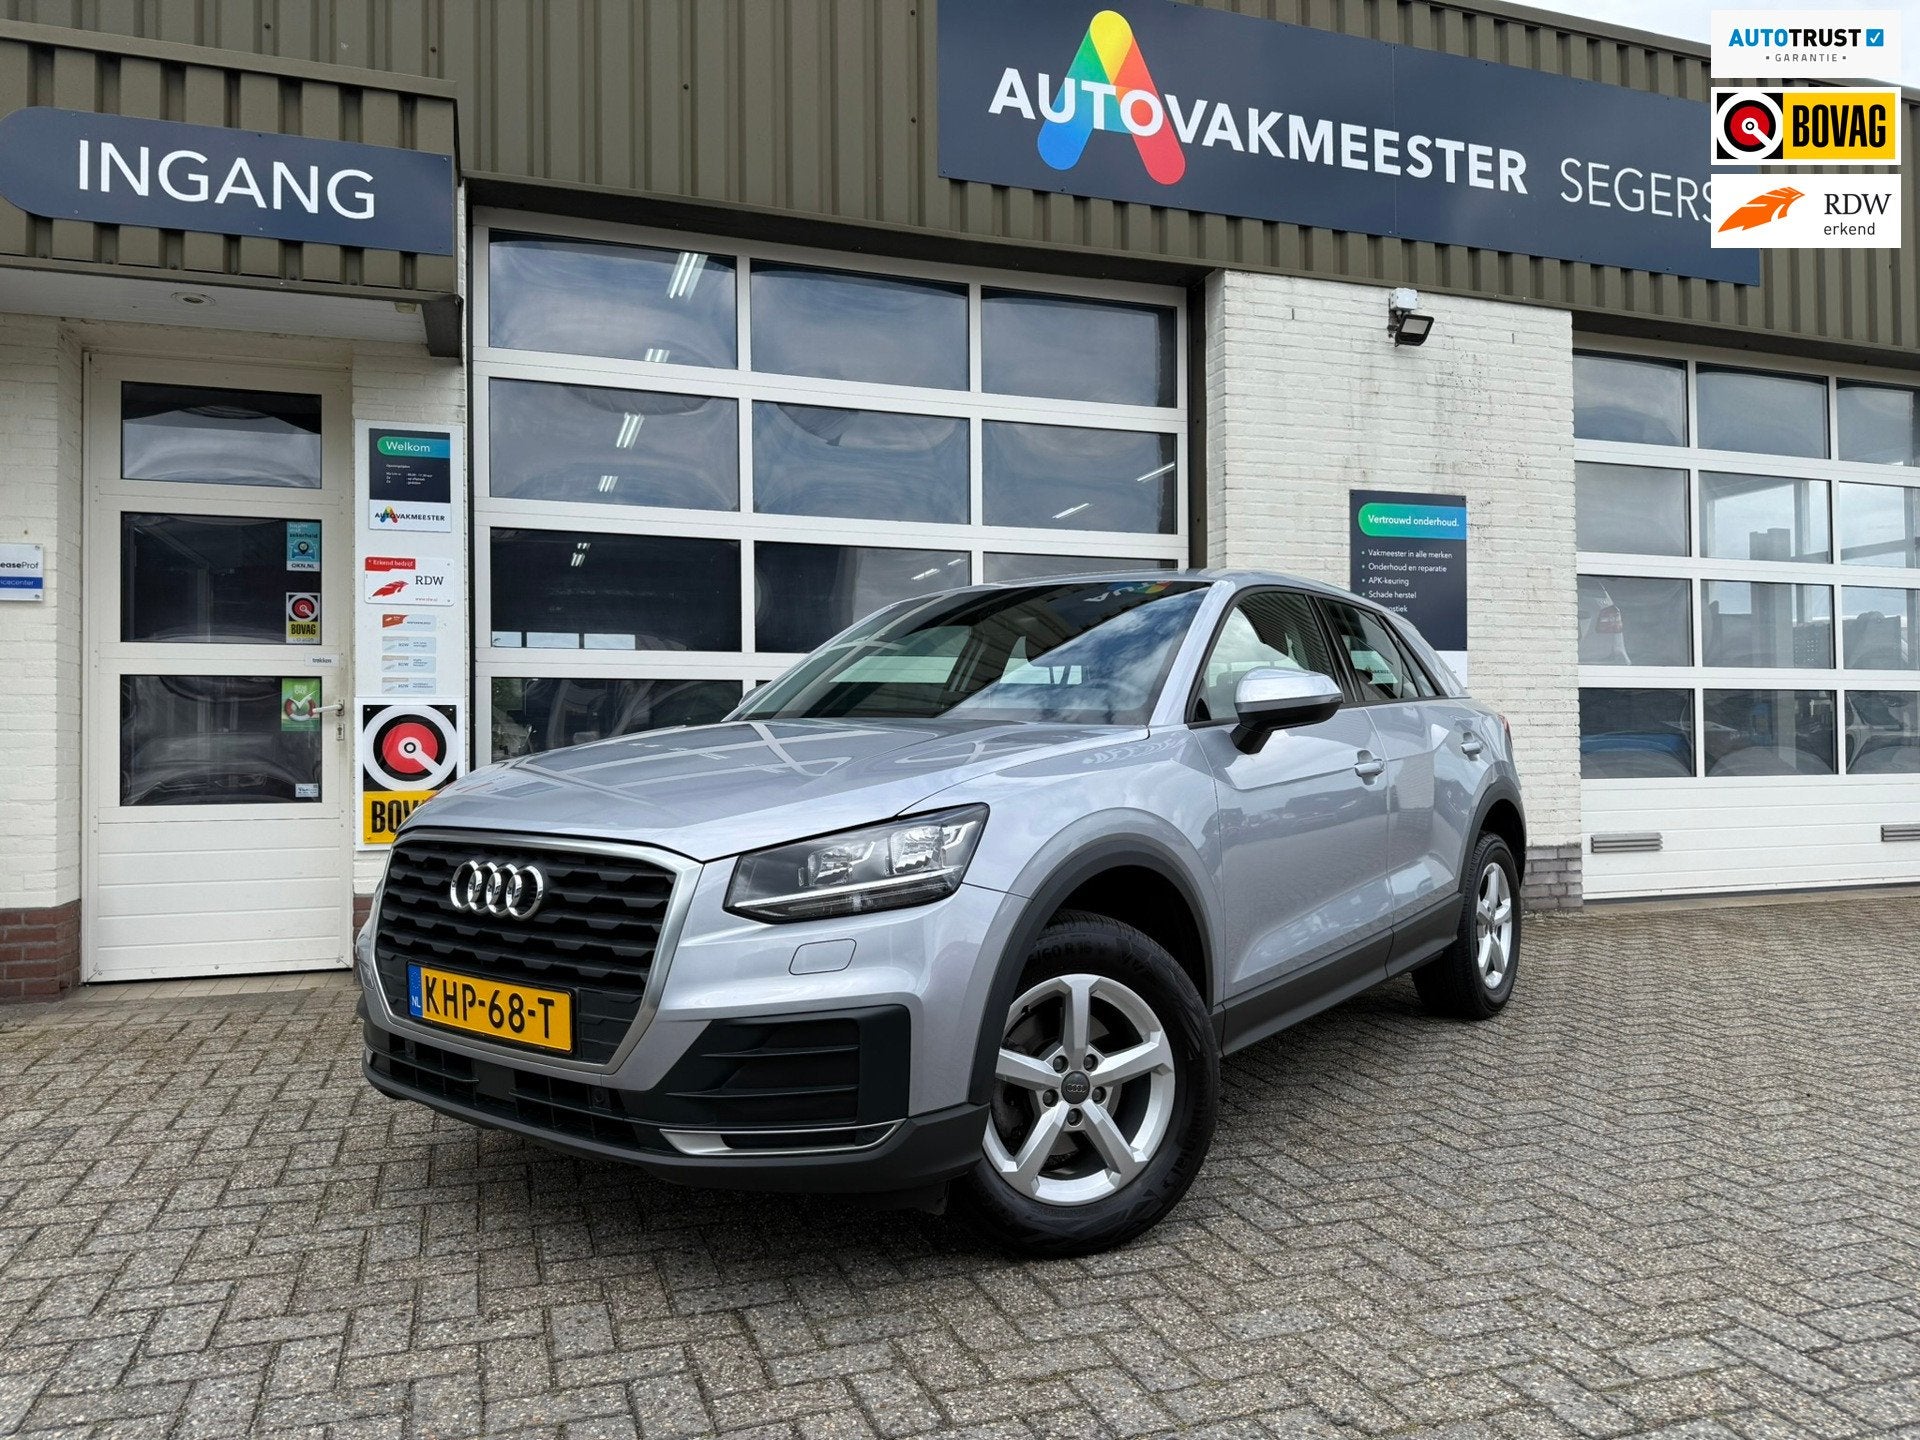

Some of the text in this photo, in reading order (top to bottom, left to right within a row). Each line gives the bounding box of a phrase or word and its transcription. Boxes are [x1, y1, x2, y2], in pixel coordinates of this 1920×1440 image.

[988, 67, 1528, 195] AUTOVAKMEESTER
[78, 139, 376, 221] INGANG
[385, 440, 431, 453] Welkom
[1367, 514, 1460, 528] Vertrouwd onderhoud.
[1368, 549, 1453, 560] Vakmeester in alle merken
[1368, 562, 1407, 572] Onderhoud
[1417, 564, 1448, 574] reparatie
[415, 575, 444, 586] RDW
[1368, 576, 1410, 587] APK-keuring
[1368, 590, 1417, 599] Schade herstel
[291, 623, 316, 635] BOVAG
[411, 974, 555, 1039] NL KHP-68-T
